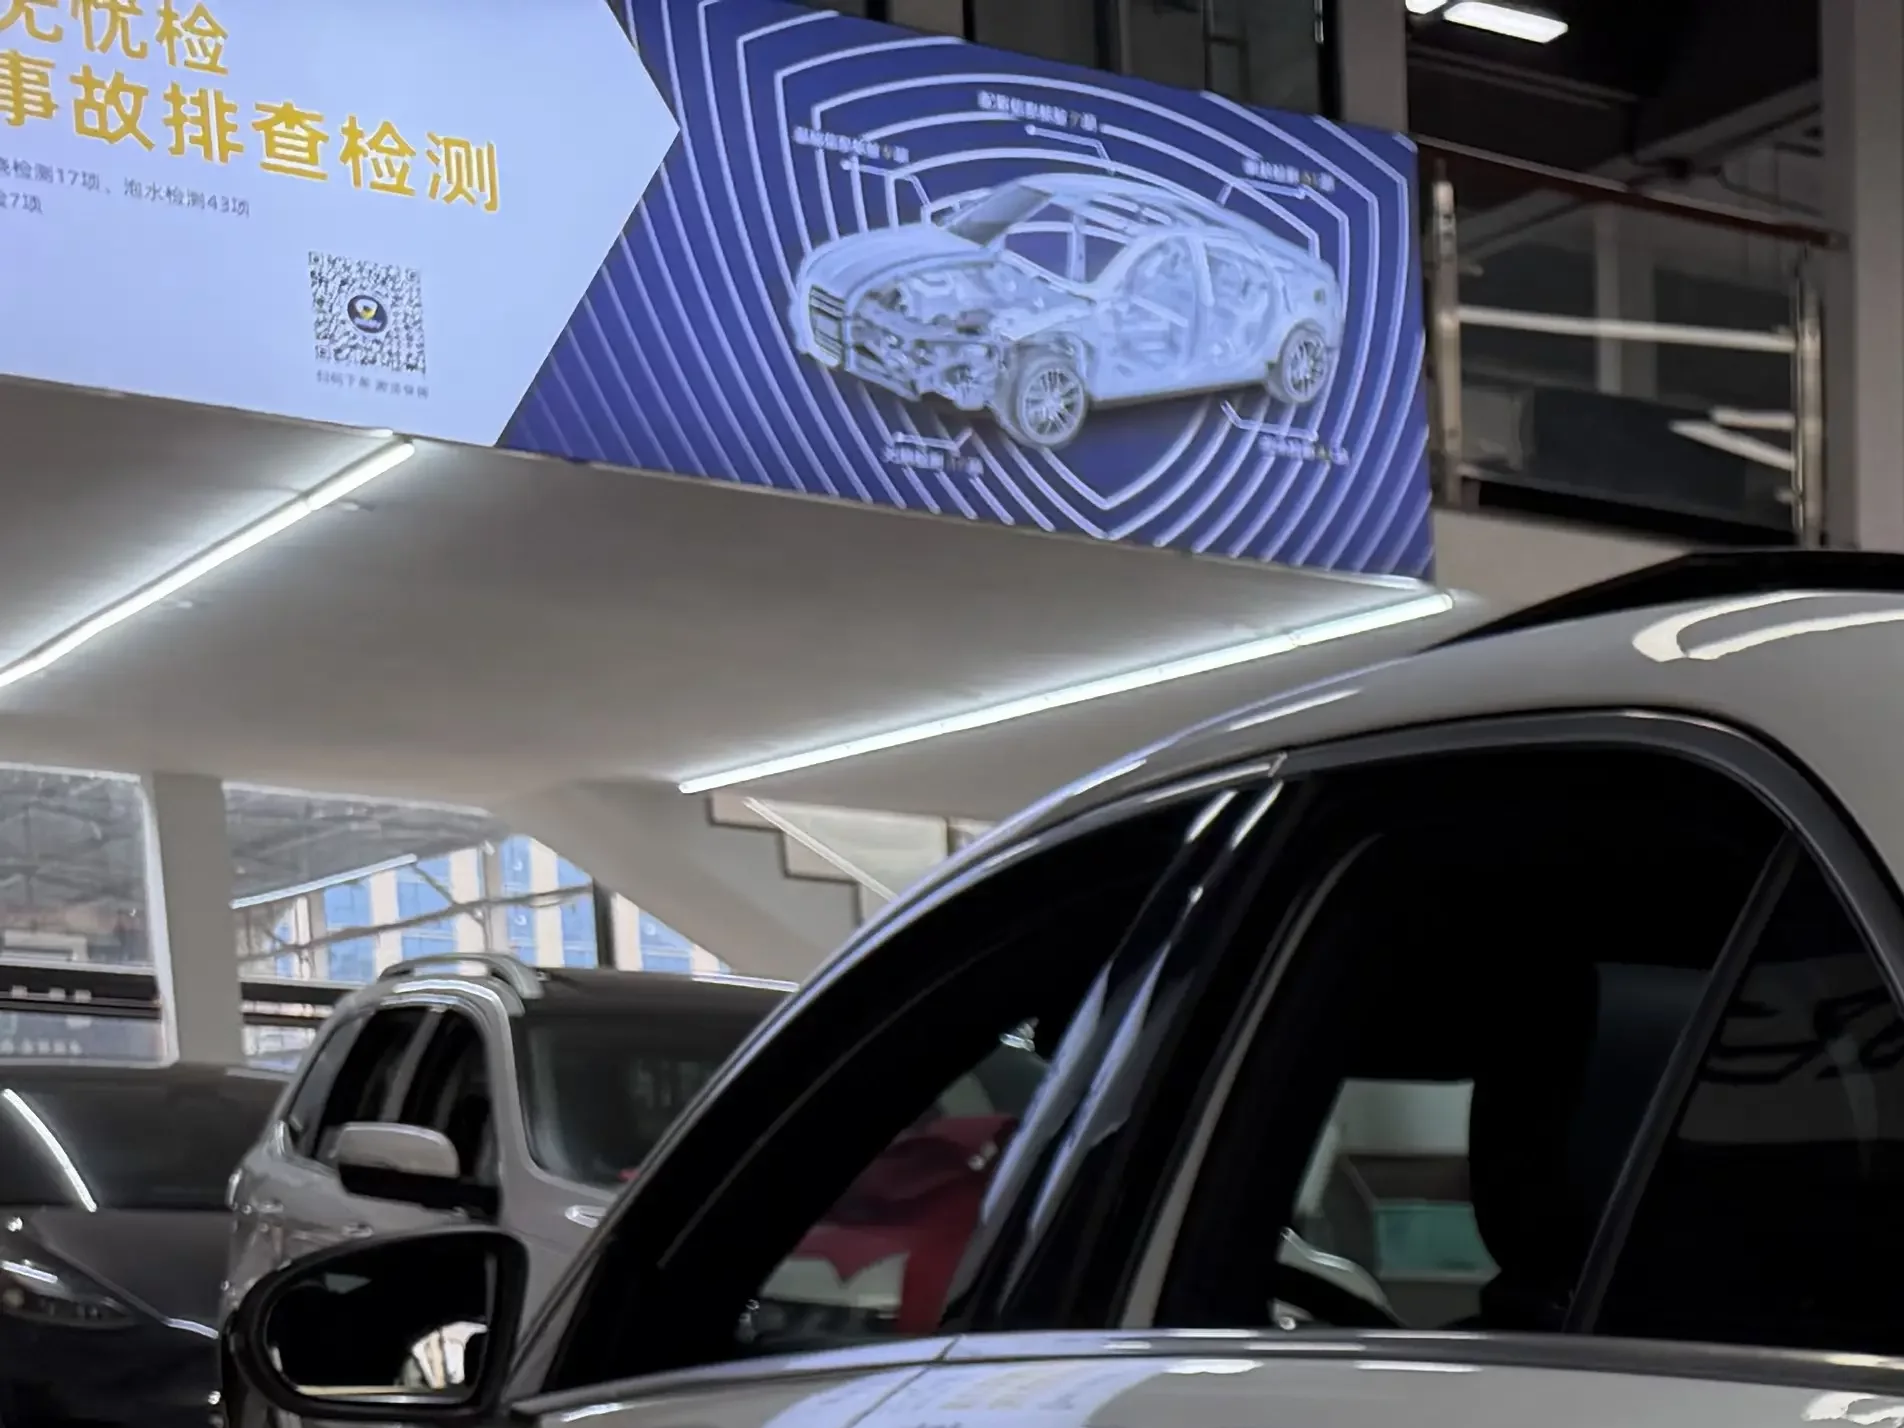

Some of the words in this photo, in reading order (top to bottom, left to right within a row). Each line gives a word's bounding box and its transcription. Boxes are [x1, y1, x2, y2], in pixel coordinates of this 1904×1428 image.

[0, 50, 500, 213] 事故排查检测
[0, 189, 43, 214] 7项
